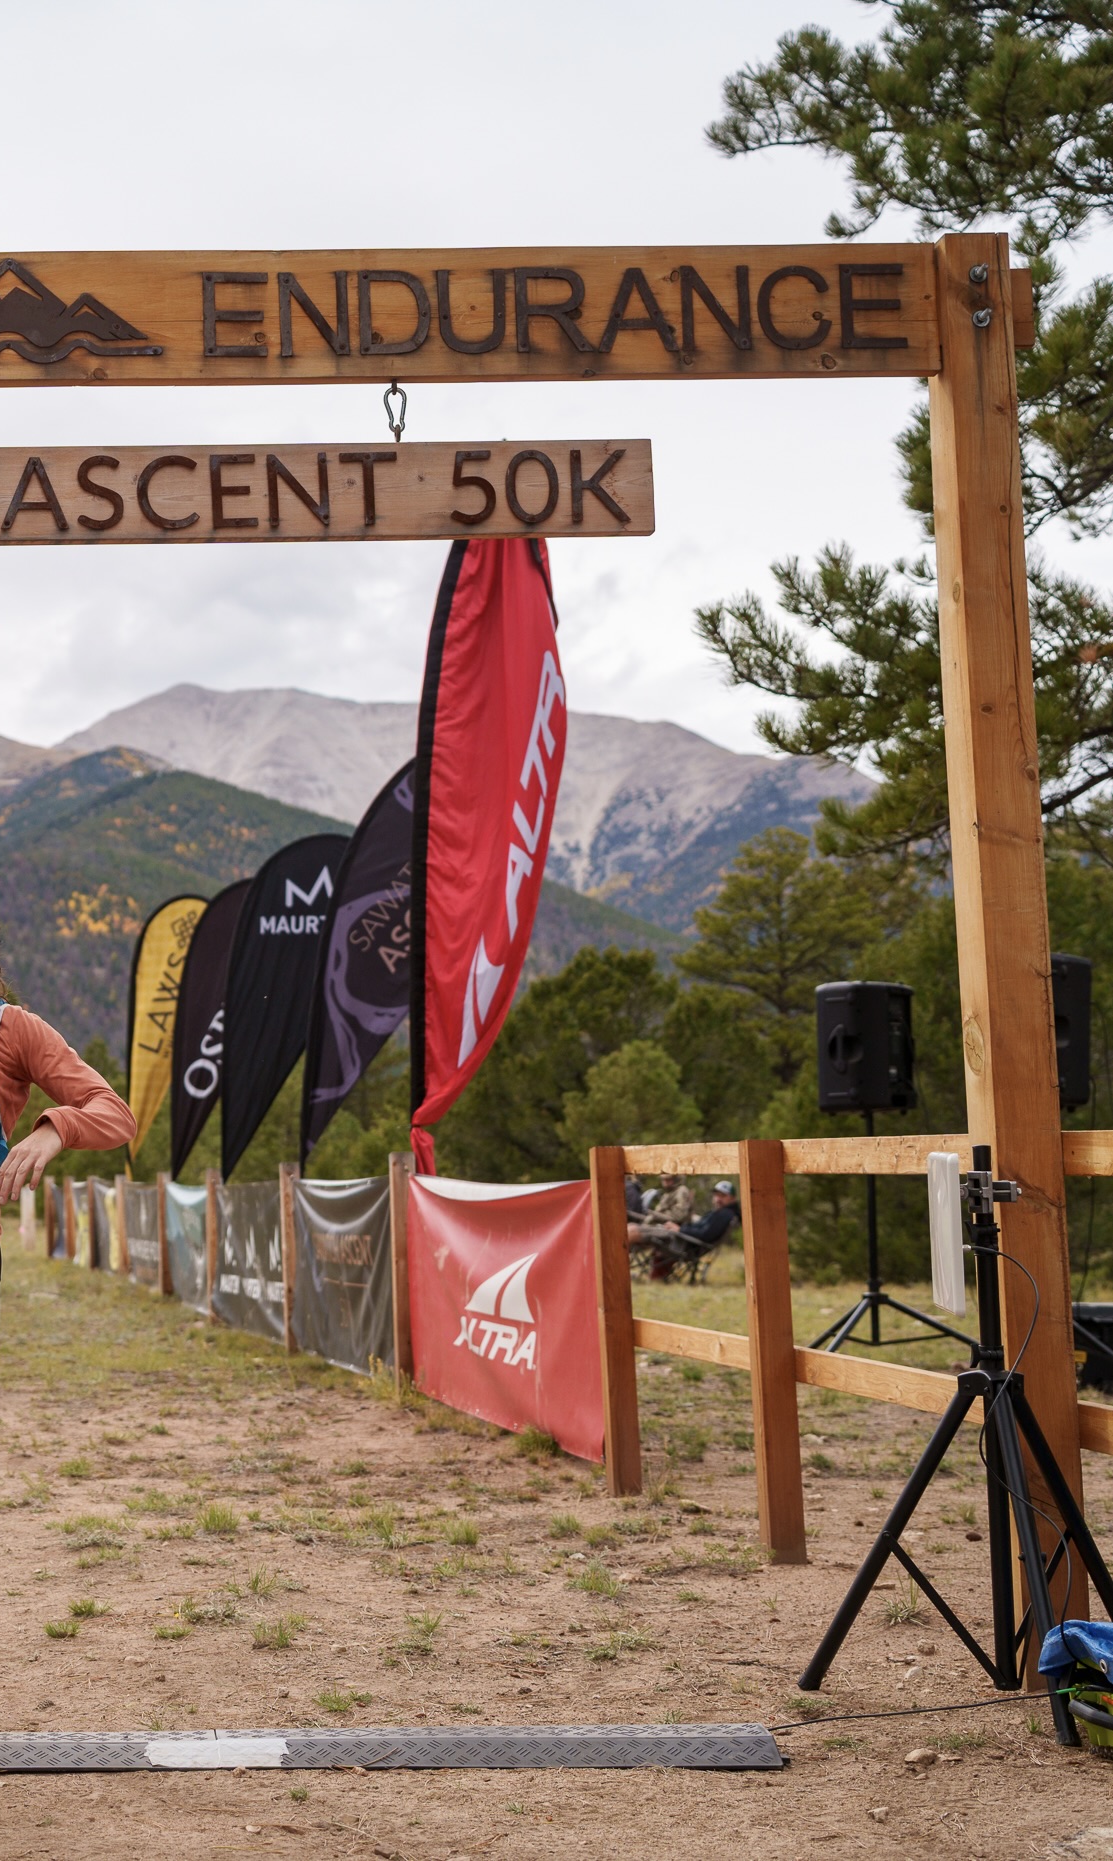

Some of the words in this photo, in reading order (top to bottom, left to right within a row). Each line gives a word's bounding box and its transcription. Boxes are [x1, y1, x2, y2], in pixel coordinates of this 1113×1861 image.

[203, 262, 909, 357] ENDURANCE
[0, 451, 397, 531] ASCENT
[449, 448, 632, 525] 50K
[505, 650, 565, 944] ALTR
[259, 915, 327, 936] MAUR
